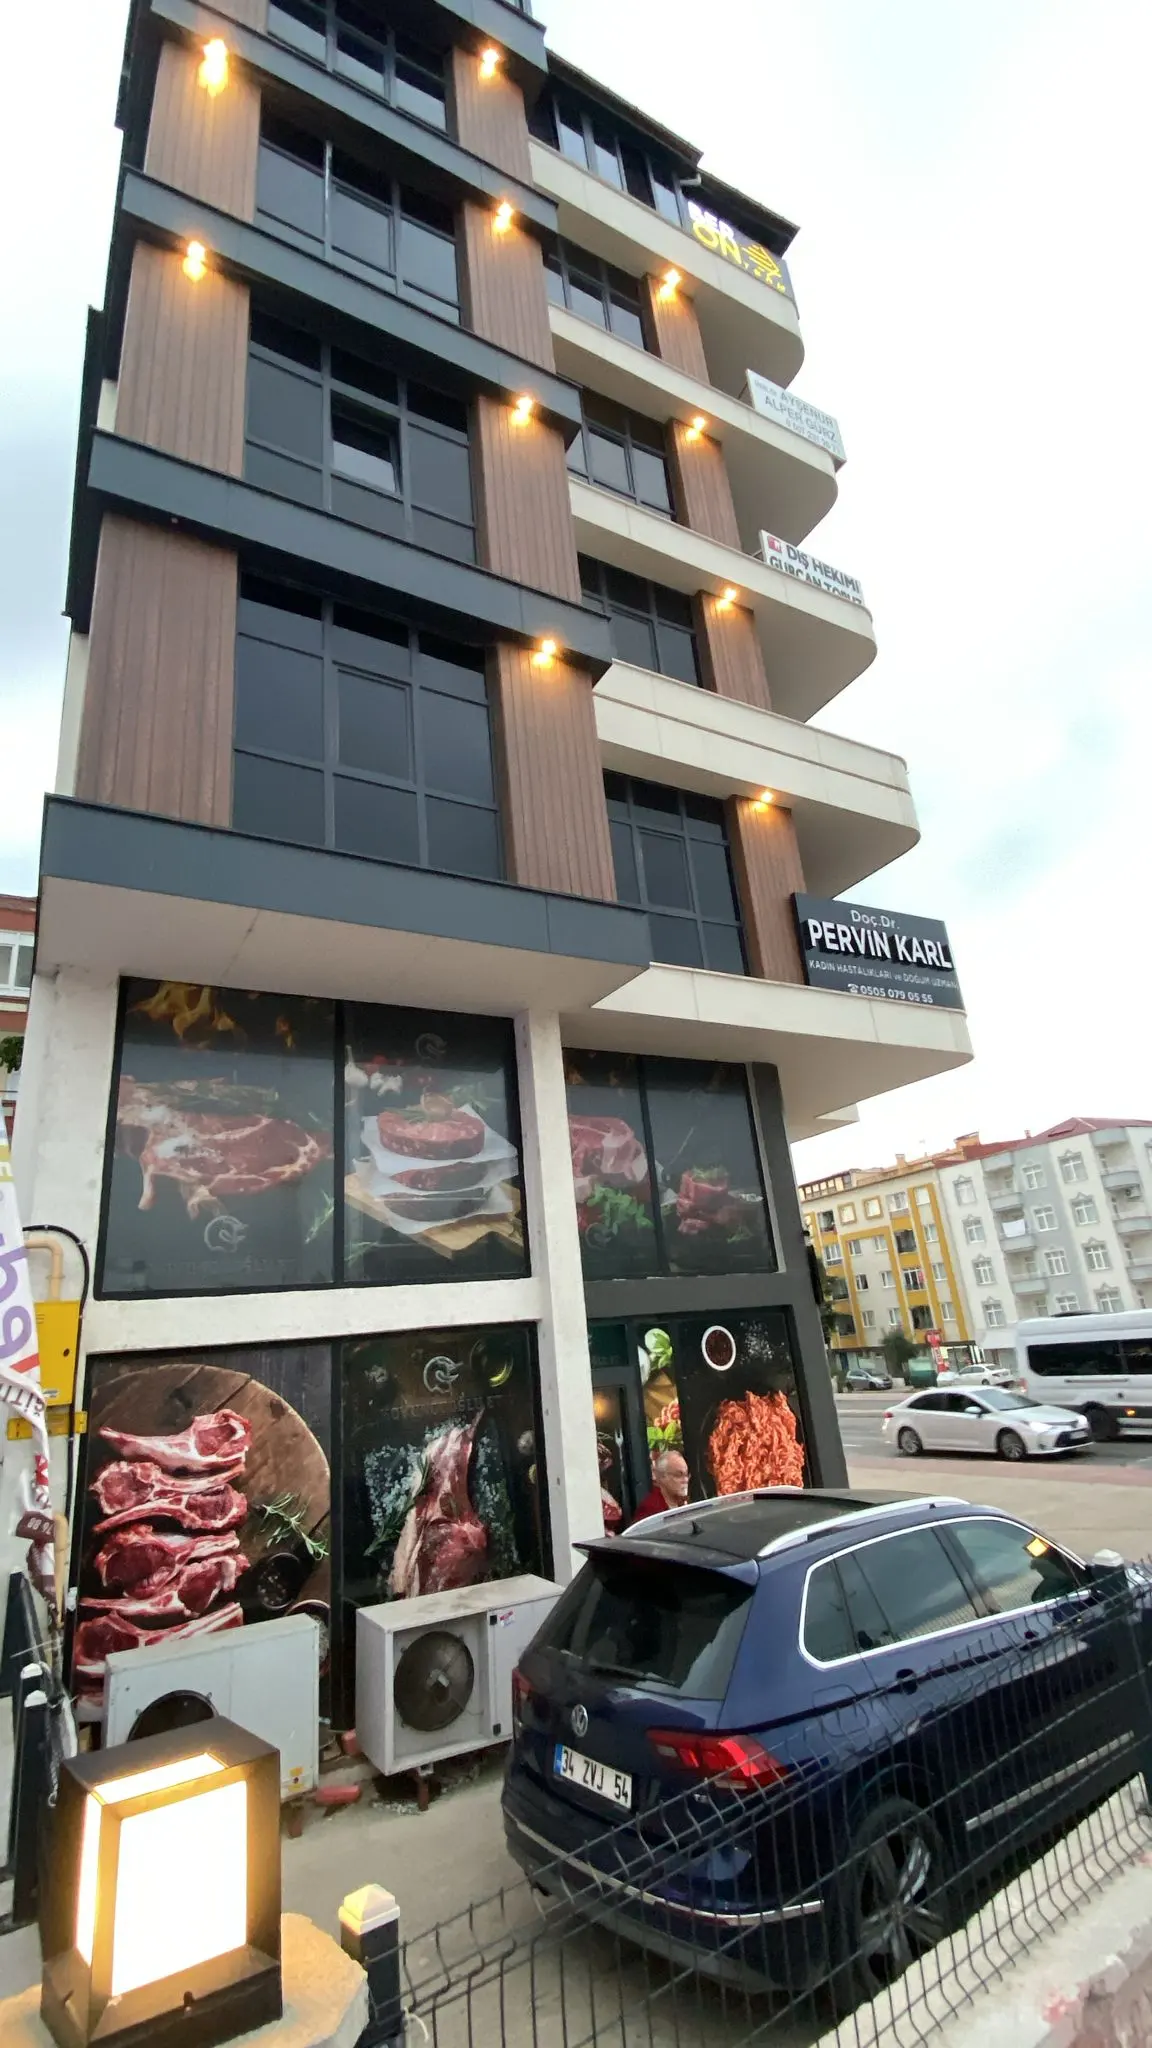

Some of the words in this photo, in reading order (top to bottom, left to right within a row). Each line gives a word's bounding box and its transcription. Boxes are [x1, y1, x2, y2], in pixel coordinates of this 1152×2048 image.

[895, 934, 952, 968] KARL
[809, 960, 836, 971] KADIN
[860, 985, 885, 998] 0505
[562, 1750, 574, 1776] 34
[582, 1760, 604, 1791] ZVJ
[614, 1774, 628, 1803] 54
